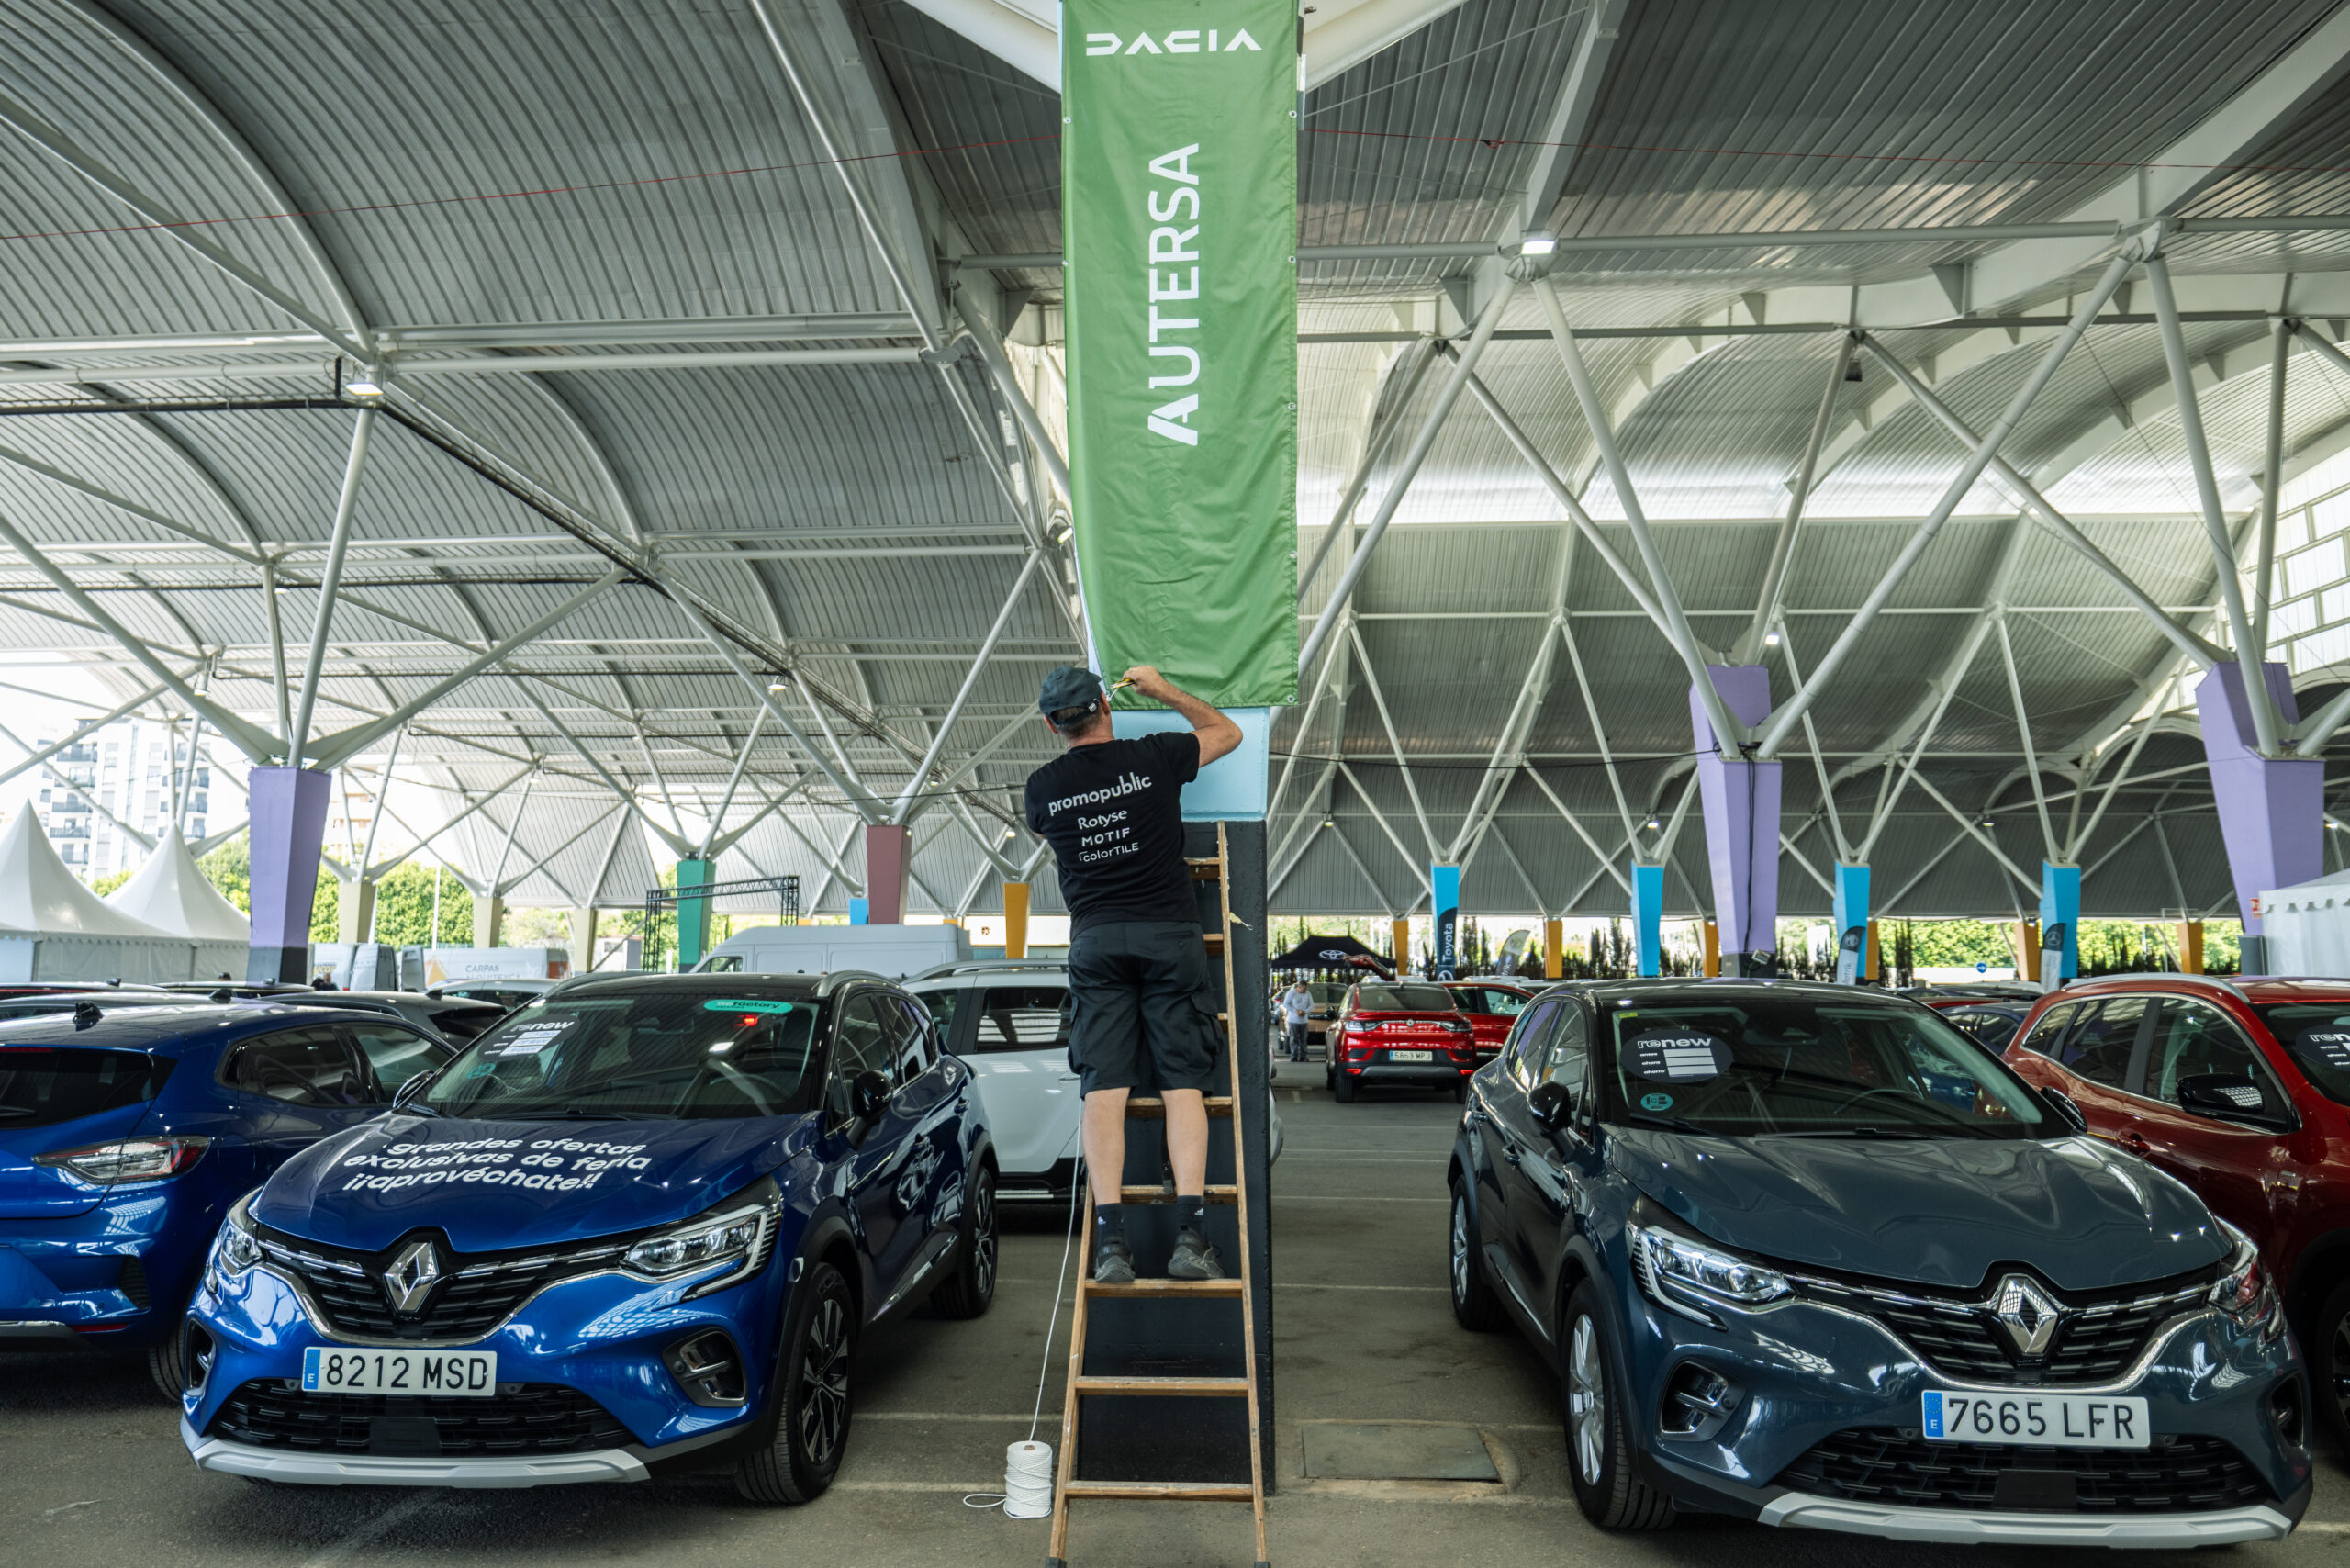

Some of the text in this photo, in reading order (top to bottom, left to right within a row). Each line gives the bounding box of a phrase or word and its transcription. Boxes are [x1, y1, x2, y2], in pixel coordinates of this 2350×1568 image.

[1086, 28, 1263, 56] DACIA
[1147, 142, 1201, 446] AUTERSA
[1048, 771, 1152, 817] promopublic
[1078, 810, 1128, 830] Rotyse
[1081, 827, 1130, 846] MOTIF
[1081, 842, 1139, 862] colorTILE
[1442, 923, 1455, 962] Toyota
[465, 965, 500, 973] CARPAS
[510, 1021, 576, 1032] renew
[1638, 1038, 1711, 1048] renew
[387, 1138, 647, 1156] grandes ofertas
[343, 1151, 652, 1171] exclusivas de feria
[308, 1354, 488, 1390] E 8212 MSD
[1930, 1398, 2134, 1439] E 7665 LFR
